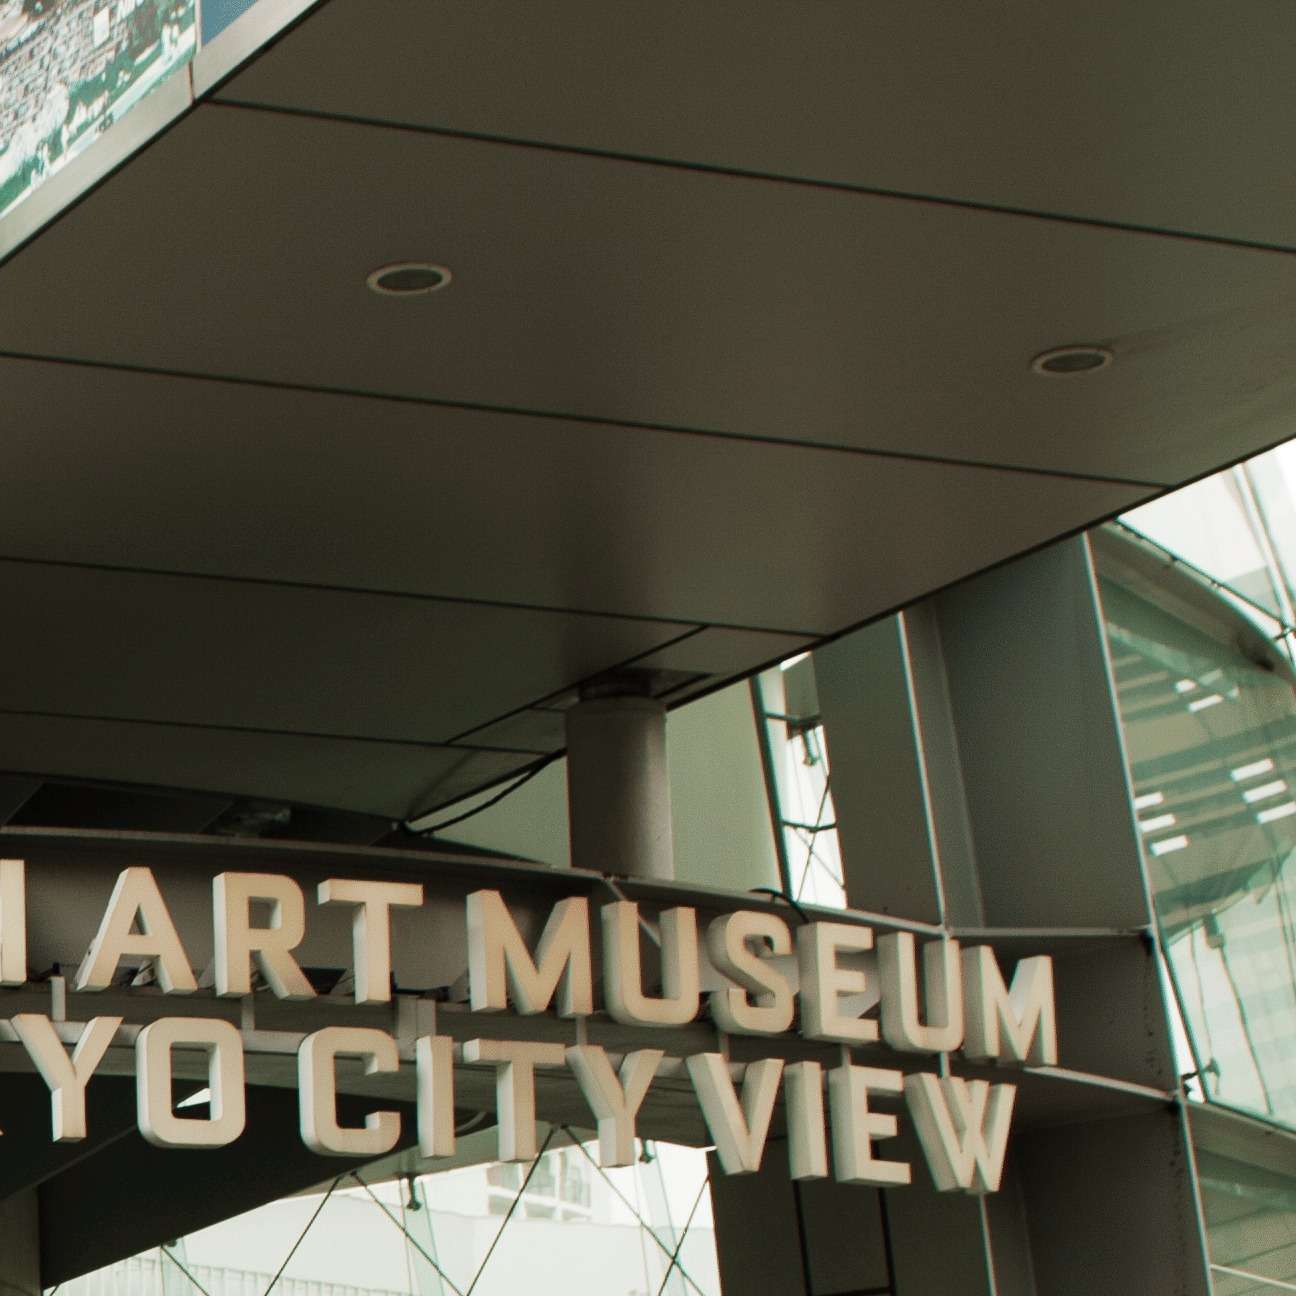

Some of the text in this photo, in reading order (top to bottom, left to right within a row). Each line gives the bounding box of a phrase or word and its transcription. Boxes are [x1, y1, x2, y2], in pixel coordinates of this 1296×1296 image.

[75, 866, 423, 1003] ART
[466, 889, 1056, 1068] MUSEUM
[297, 1026, 665, 1167] CITY
[686, 1052, 1016, 1194] VIEW
